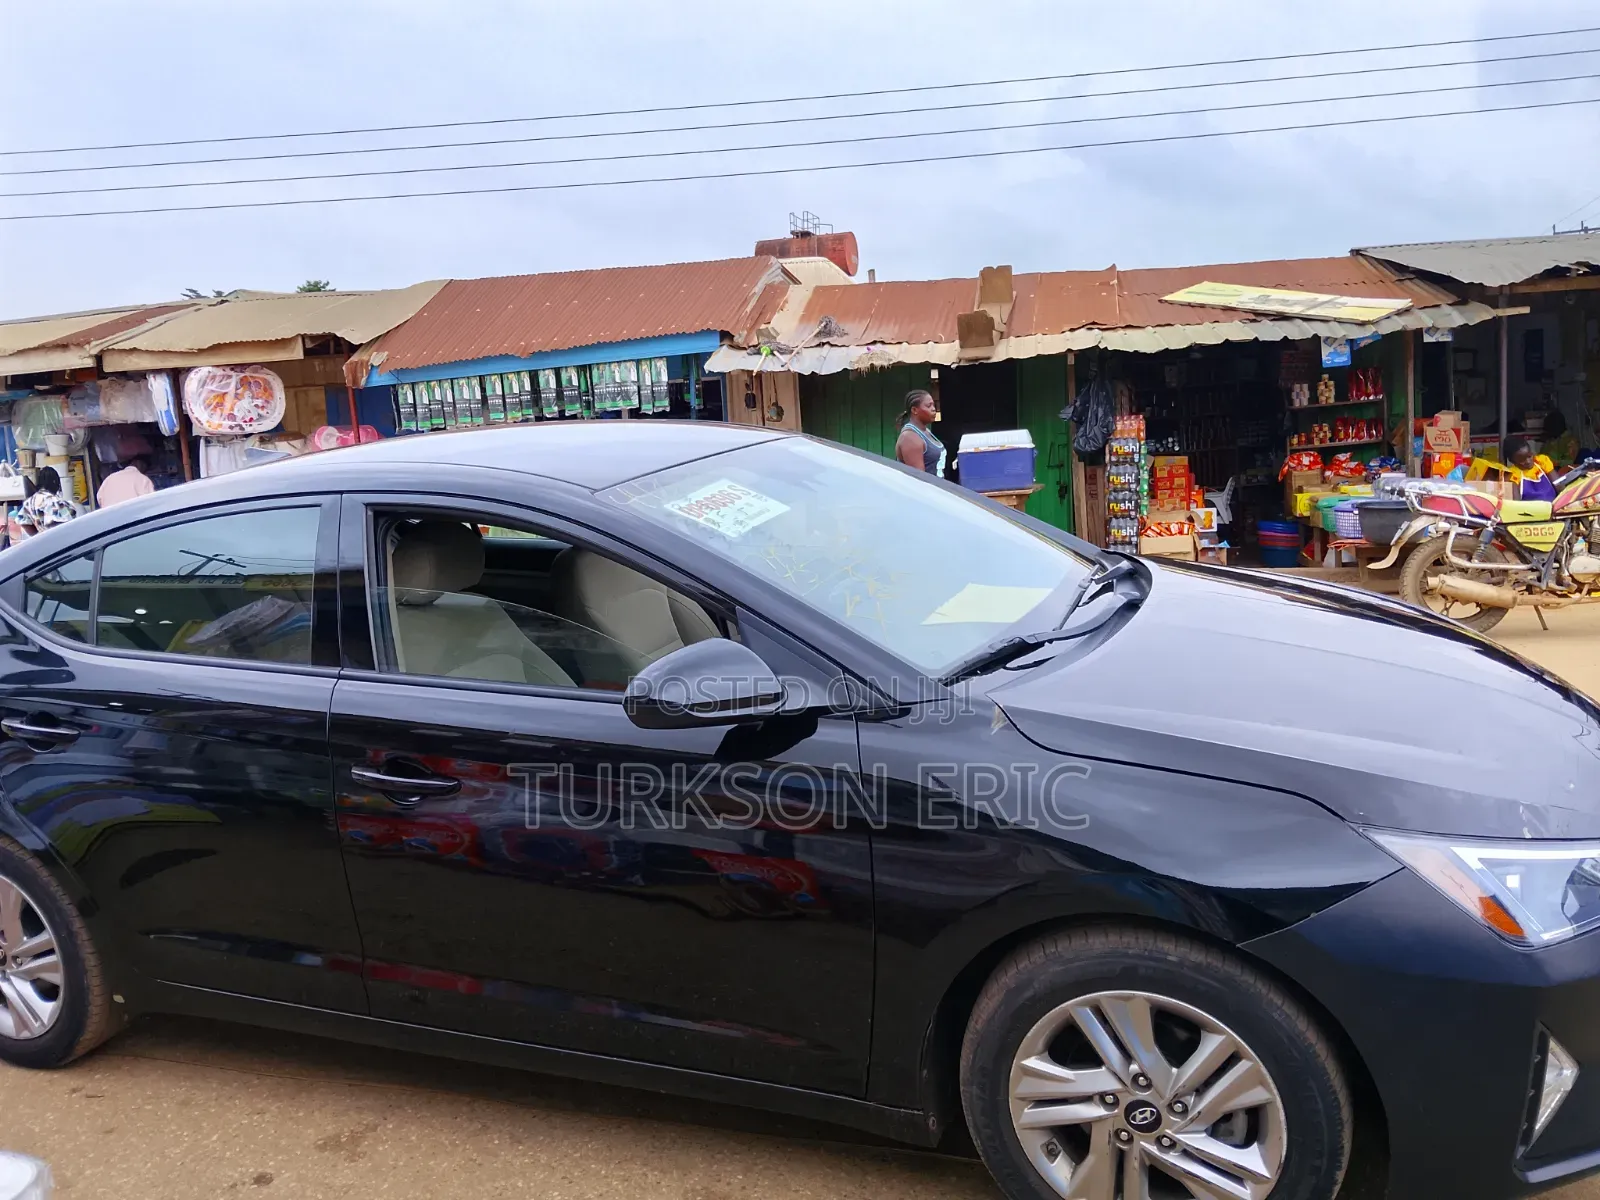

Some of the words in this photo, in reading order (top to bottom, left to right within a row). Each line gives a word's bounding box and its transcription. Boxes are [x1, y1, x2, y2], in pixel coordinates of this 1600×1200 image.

[1113, 442, 1140, 455] rush!
[1110, 472, 1135, 485] rush!
[1110, 500, 1135, 512] rush!
[1111, 526, 1137, 538] rush!
